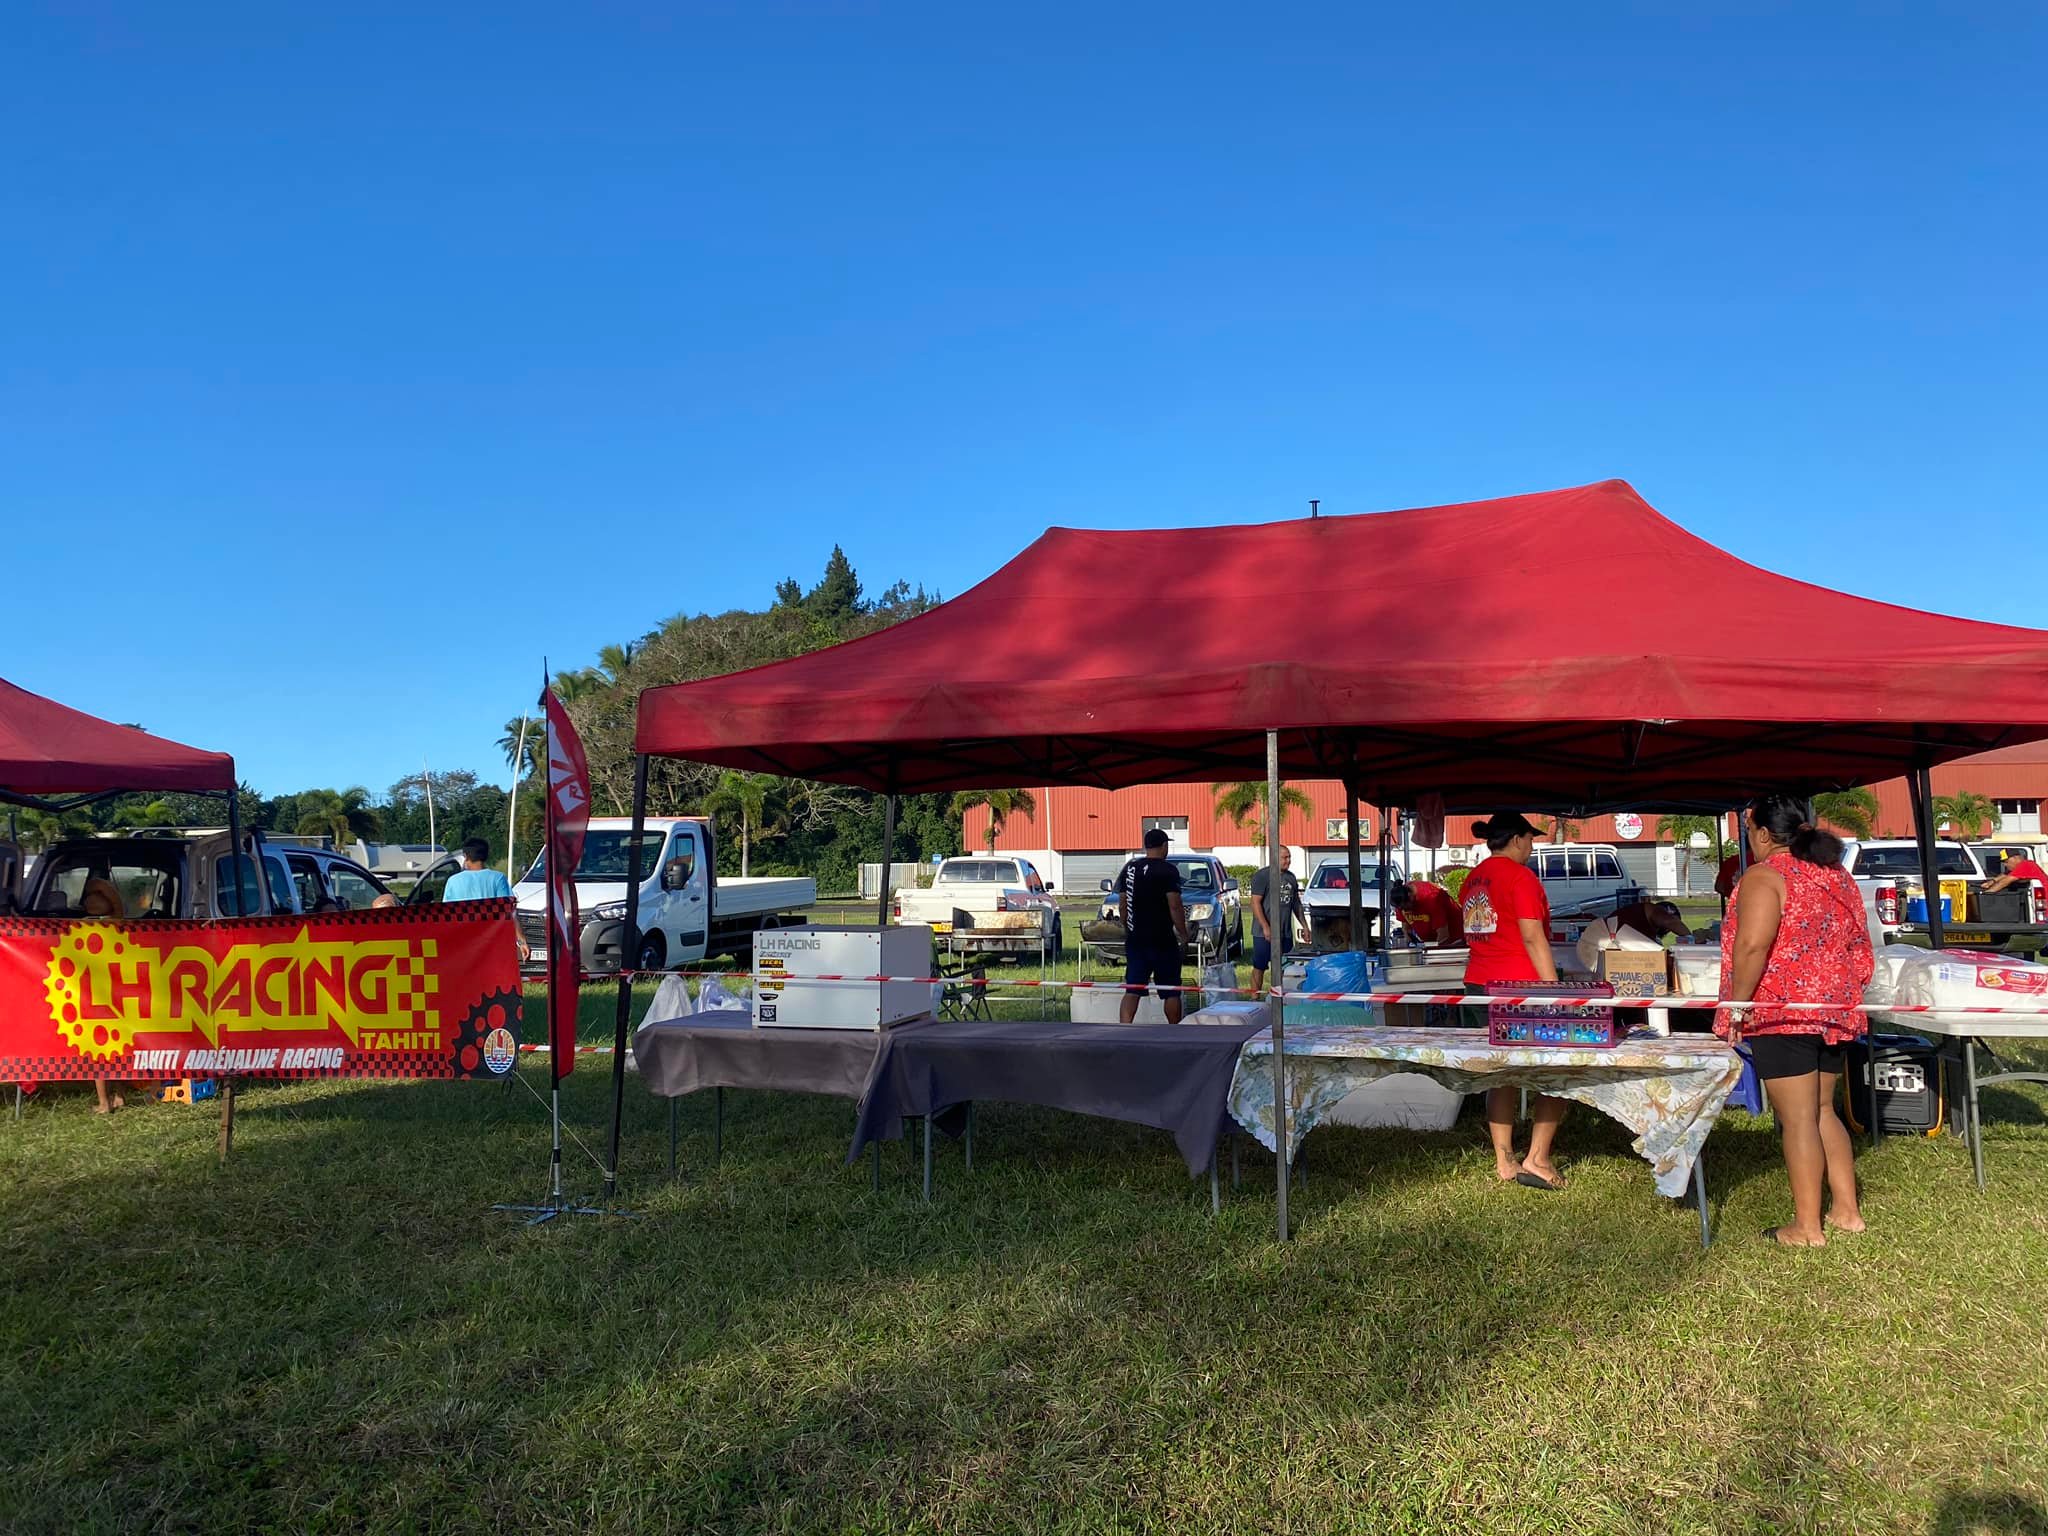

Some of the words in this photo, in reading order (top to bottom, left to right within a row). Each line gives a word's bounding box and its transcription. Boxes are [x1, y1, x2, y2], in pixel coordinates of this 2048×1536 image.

[760, 939, 776, 950] LH
[778, 939, 821, 950] RACING
[79, 960, 152, 1020] LH
[168, 953, 395, 1019] RACING
[360, 1032, 441, 1050] TAHITI
[133, 1049, 180, 1070] TAHITI
[183, 1046, 280, 1070] ADRÉNALINE
[280, 1047, 344, 1069] RACING
